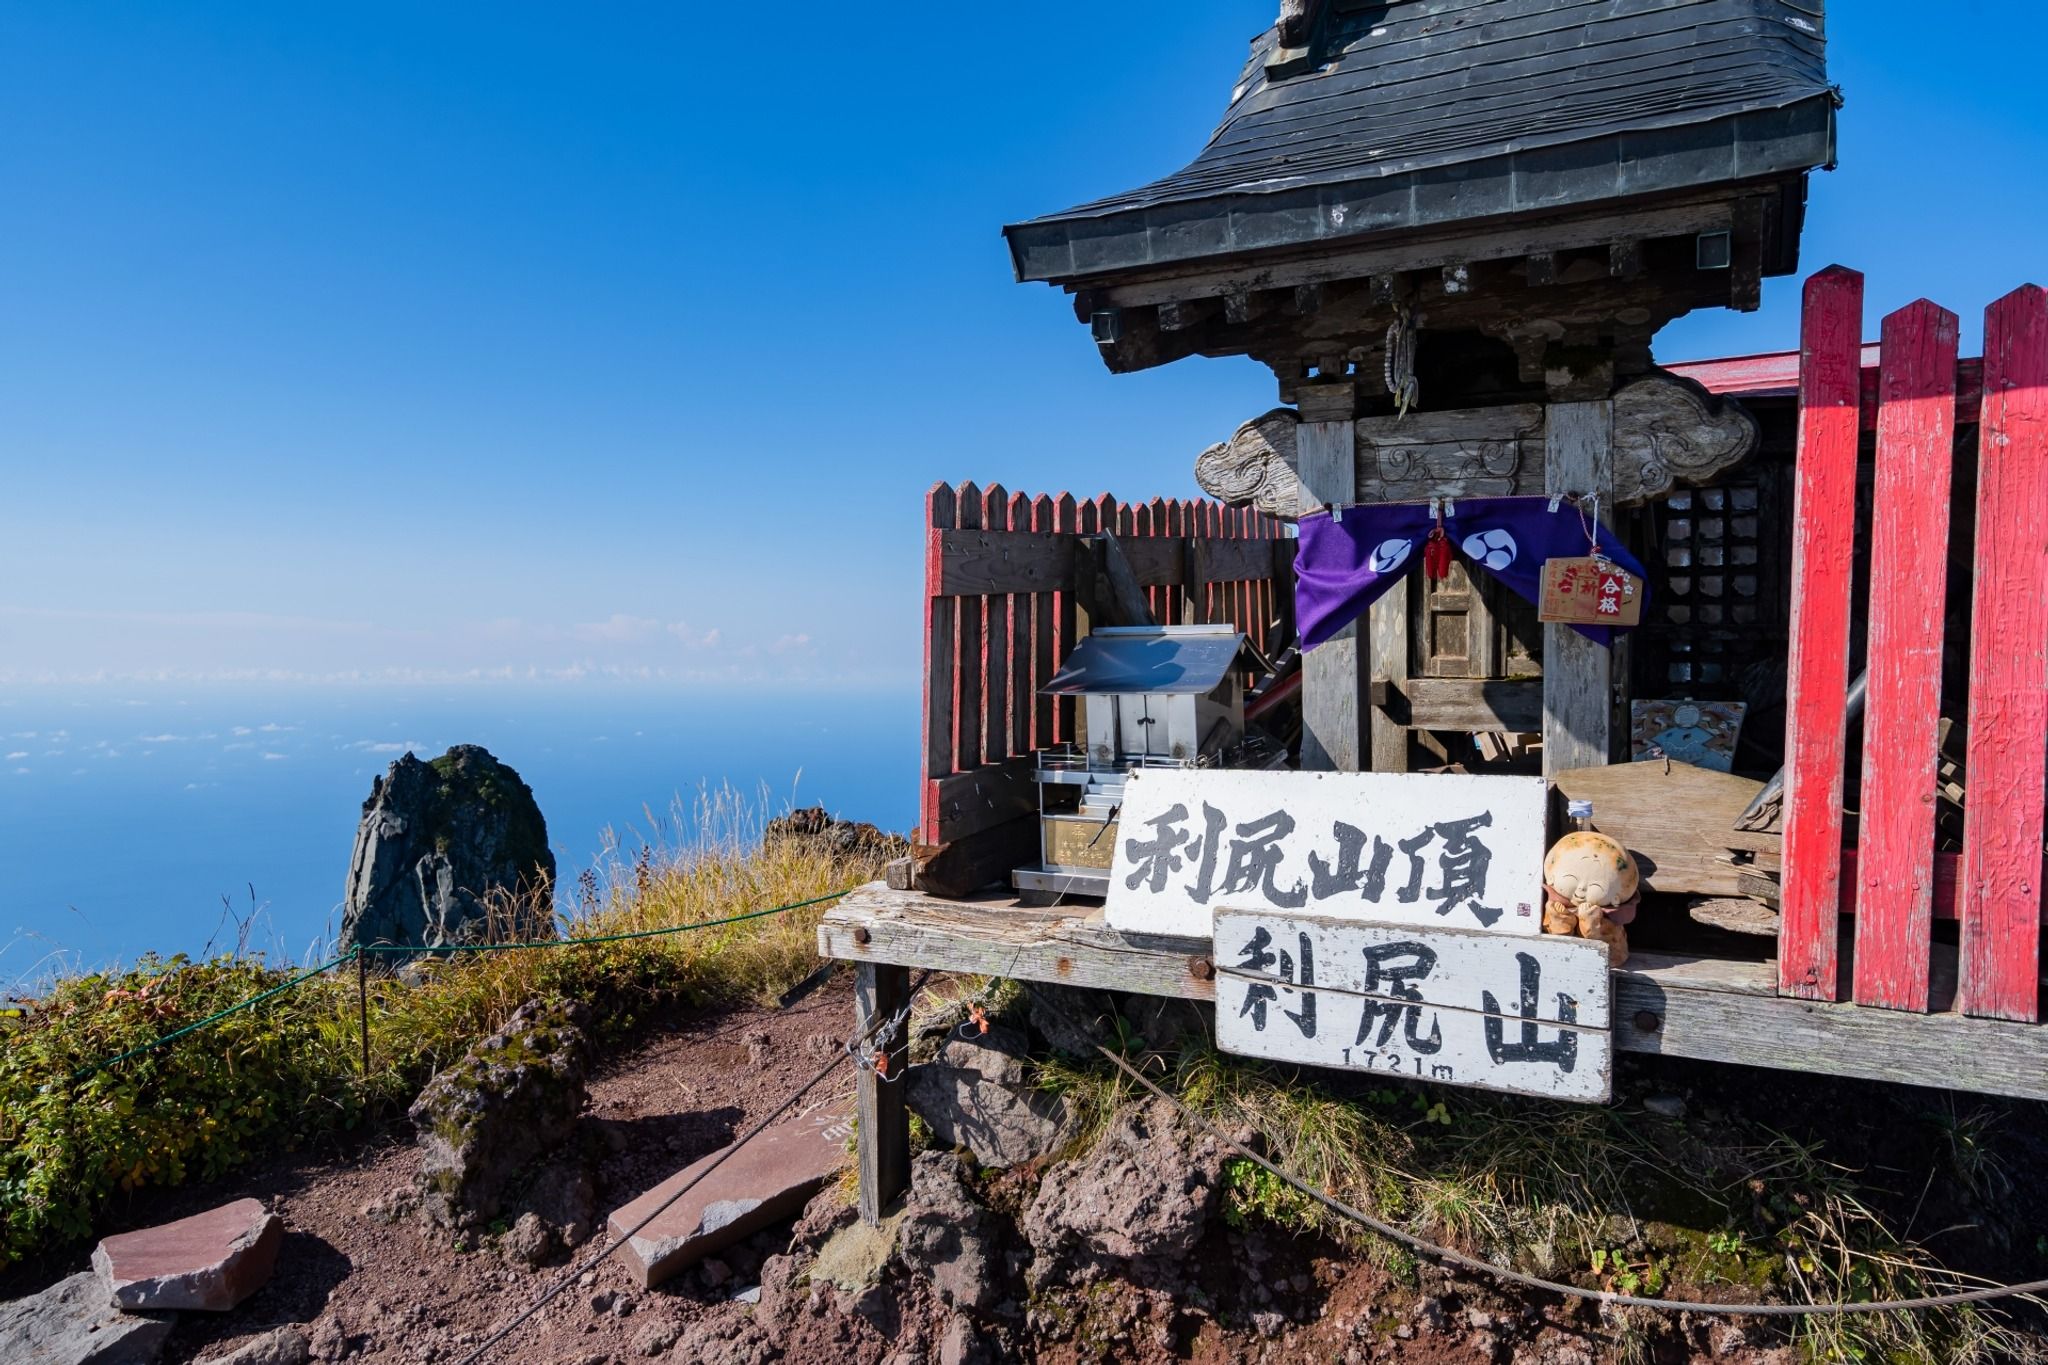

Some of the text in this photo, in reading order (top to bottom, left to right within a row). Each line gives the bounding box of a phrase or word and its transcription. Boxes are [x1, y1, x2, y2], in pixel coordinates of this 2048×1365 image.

[1597, 576, 1621, 613] 合格
[1125, 799, 1503, 928] 利尻山頂
[1236, 926, 1579, 1074] 利尻山
[1342, 1047, 1454, 1081] 1721m
